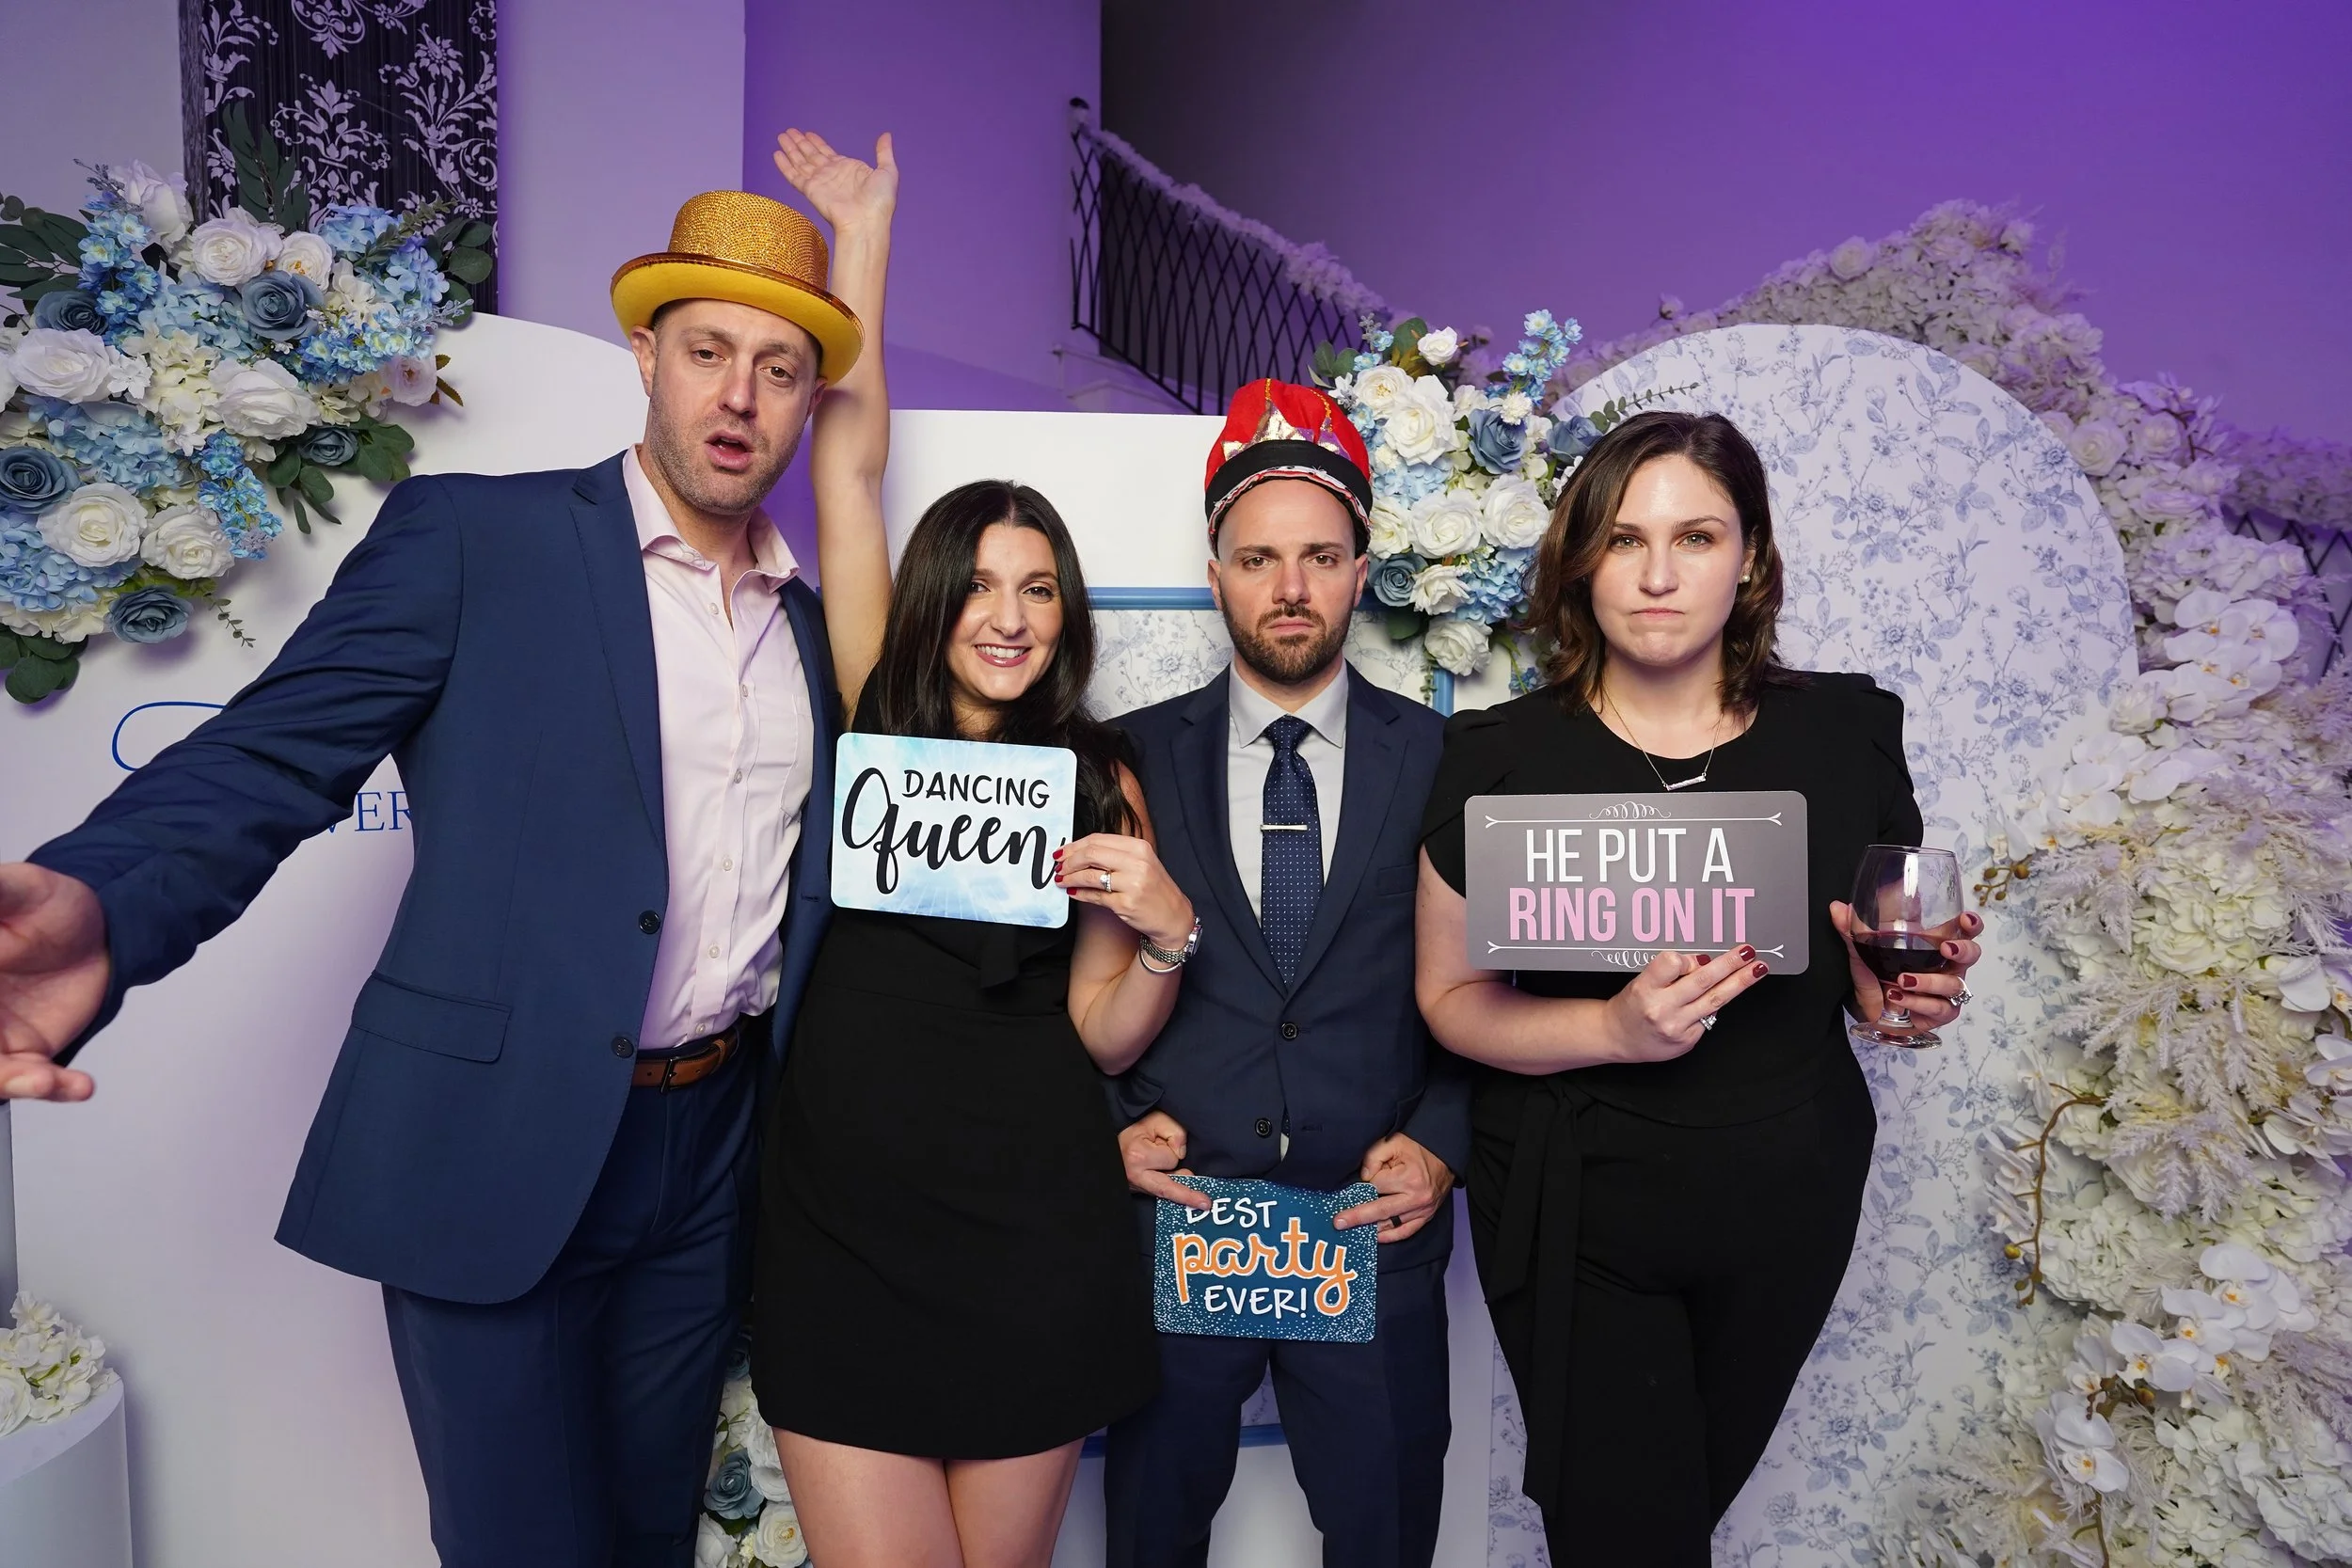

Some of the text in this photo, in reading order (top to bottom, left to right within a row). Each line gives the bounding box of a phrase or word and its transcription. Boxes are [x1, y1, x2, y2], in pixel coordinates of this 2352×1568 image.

[901, 769, 1050, 809] DANCING
[841, 767, 1066, 895] Queen
[1525, 827, 1735, 883] HE PUT A
[1509, 887, 1756, 943] RING ON IT
[1172, 1216, 1359, 1317] party
[1203, 1285, 1308, 1320] EVER!
